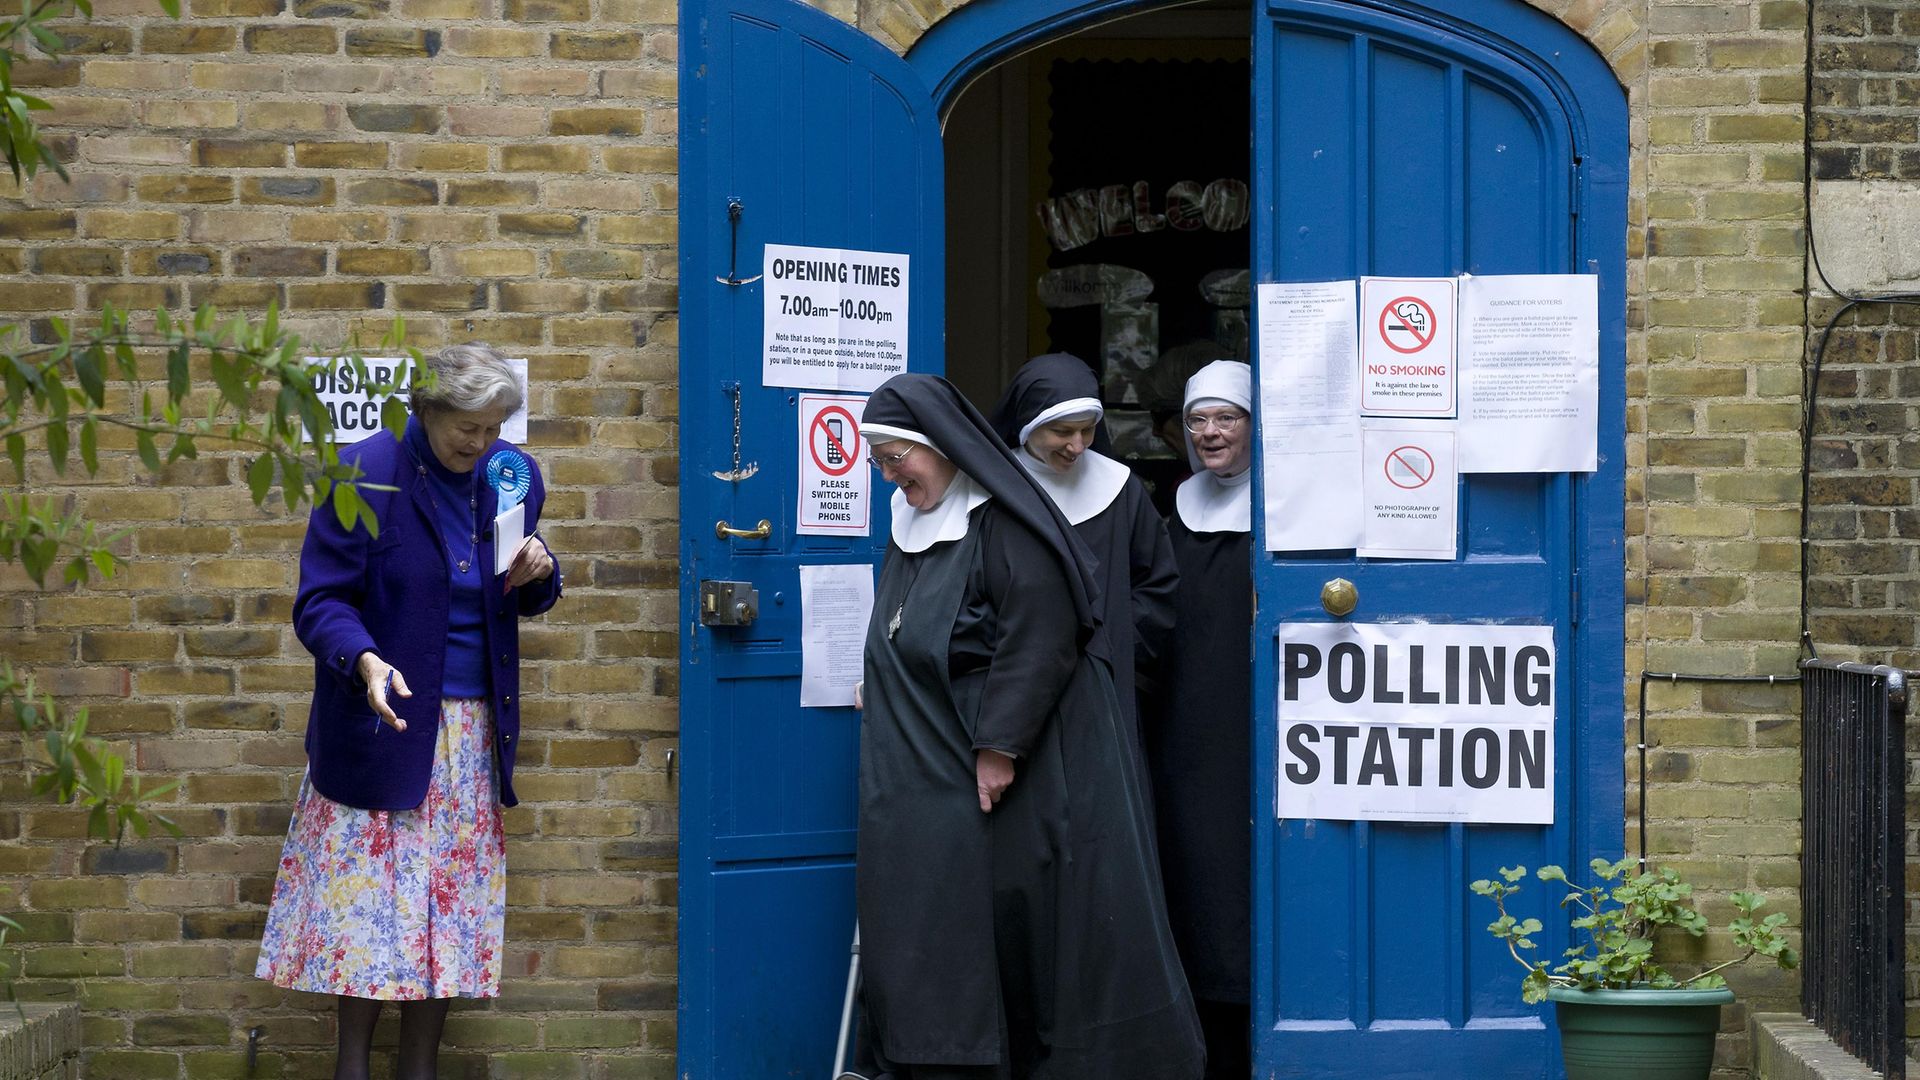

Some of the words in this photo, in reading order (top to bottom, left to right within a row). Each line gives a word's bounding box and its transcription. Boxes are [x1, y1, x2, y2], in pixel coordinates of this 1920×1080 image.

[772, 258, 848, 284] OPENING
[852, 264, 900, 288] TIMES
[1537, 298, 1562, 306] VOTERS
[776, 332, 789, 340] Note
[790, 334, 802, 342] that
[813, 335, 826, 345] long
[838, 338, 846, 346] you
[858, 338, 863, 346] in
[876, 340, 896, 350] polling
[800, 346, 806, 354] in
[813, 348, 833, 356] queue
[857, 350, 875, 358] before
[878, 351, 902, 361] 10.00pm
[770, 358, 780, 366] you
[793, 357, 800, 365] be
[802, 358, 825, 366] entitled
[836, 360, 849, 370] apply
[866, 362, 882, 370] ballot
[884, 364, 901, 373] paper
[1368, 364, 1387, 375] NO
[1390, 365, 1446, 376] SMOKING
[312, 365, 416, 394] DISAB
[324, 401, 412, 430] ACC
[820, 480, 850, 489] PLEASE
[812, 490, 842, 499] SWITCH
[844, 492, 859, 500] OFF
[820, 502, 850, 510] MOBILE
[818, 513, 851, 521] PHONES
[1284, 642, 1551, 707] POLLING
[1285, 724, 1546, 790] STATION
